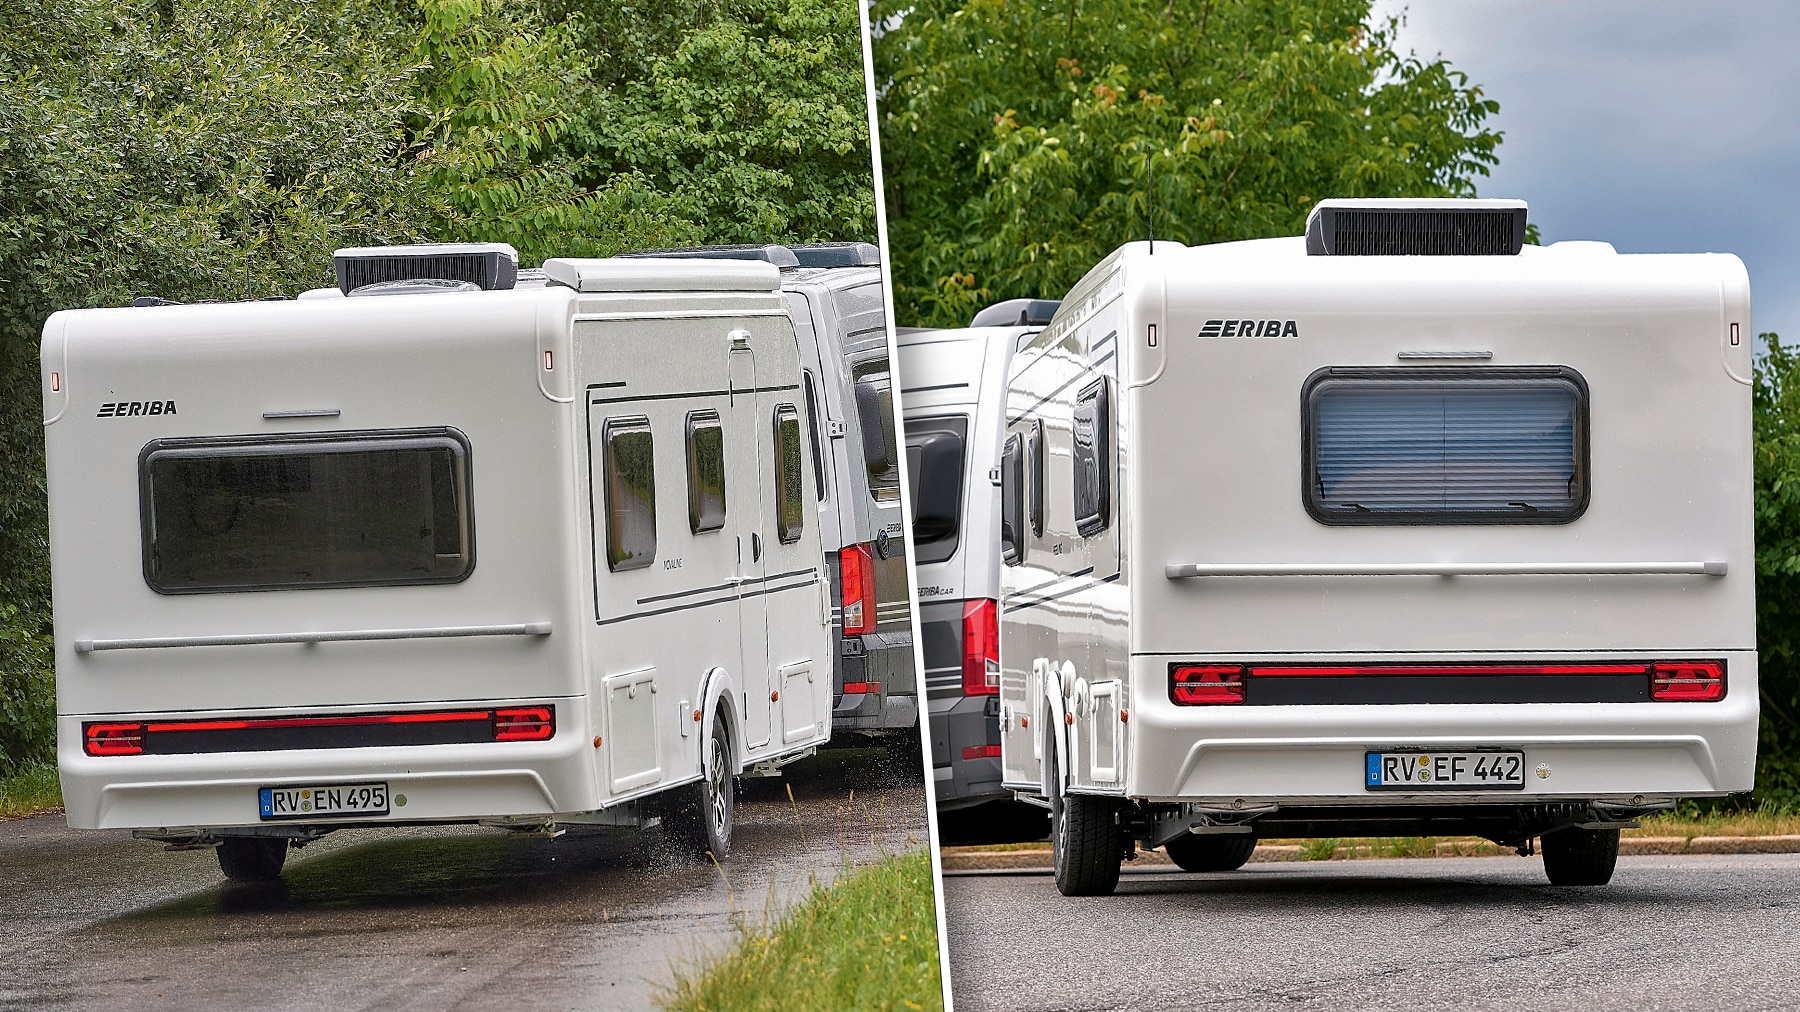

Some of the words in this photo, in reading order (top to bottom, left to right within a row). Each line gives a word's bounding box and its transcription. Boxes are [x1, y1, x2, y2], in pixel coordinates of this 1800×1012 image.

[1220, 320, 1299, 338] ERIBA
[115, 400, 177, 417] ERIBA
[1371, 772, 1378, 780] D
[1383, 756, 1416, 782] RV
[1434, 756, 1467, 782] EF
[1473, 756, 1521, 782] 442
[273, 791, 300, 812] RV
[314, 789, 342, 810] EN
[346, 787, 385, 809] 495
